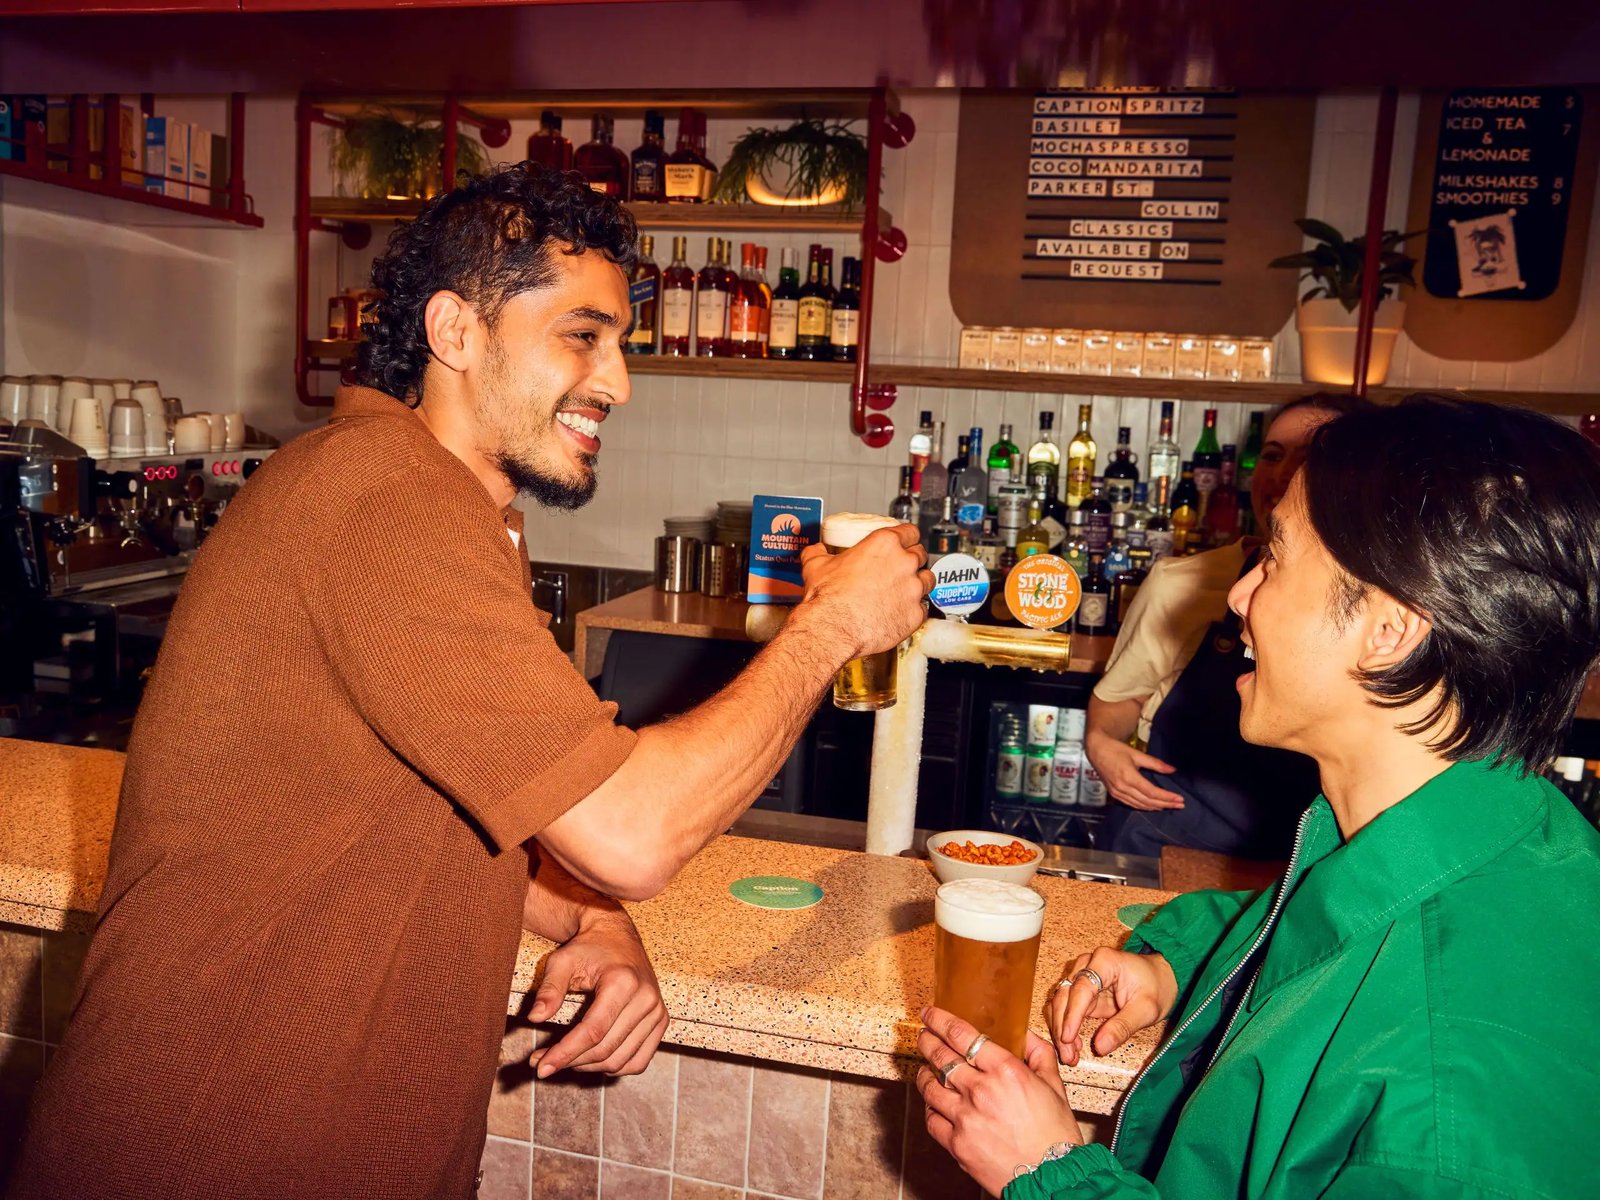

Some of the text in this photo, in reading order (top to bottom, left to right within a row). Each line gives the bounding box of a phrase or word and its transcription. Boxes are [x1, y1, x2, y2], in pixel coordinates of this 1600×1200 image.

[1035, 100, 1202, 113] CAPTION SPRITZ
[1448, 96, 1541, 109] HOMEMADE
[1034, 120, 1118, 133] BASILET
[1446, 117, 1526, 130] ICED TEA
[1562, 124, 1572, 136] 7
[1481, 131, 1493, 145] &
[1031, 140, 1189, 154] MOCHASPRESSO
[1441, 149, 1531, 162] LEMONADE
[1031, 161, 1201, 176] COCO MANDARITA
[1031, 181, 1104, 194] PARKER
[1438, 175, 1564, 190] MILKSHAKES 8
[1436, 191, 1562, 205] SMOOTHIES 9
[1143, 203, 1219, 217] COLLIN
[1071, 222, 1171, 236] CLASSICS
[1038, 243, 1188, 258] AVAILABLE ON
[1072, 262, 1162, 278] REQUEST
[761, 534, 809, 544] MOUNTAIN
[762, 541, 799, 551] CULTURE
[755, 553, 775, 562] Status
[937, 567, 980, 584] HAHN
[1017, 572, 1069, 591] STONE
[936, 585, 979, 600] SuperDry
[1034, 581, 1053, 602] &
[1017, 591, 1067, 609] WOOD
[1021, 609, 1063, 624] PACIFIC ALE
